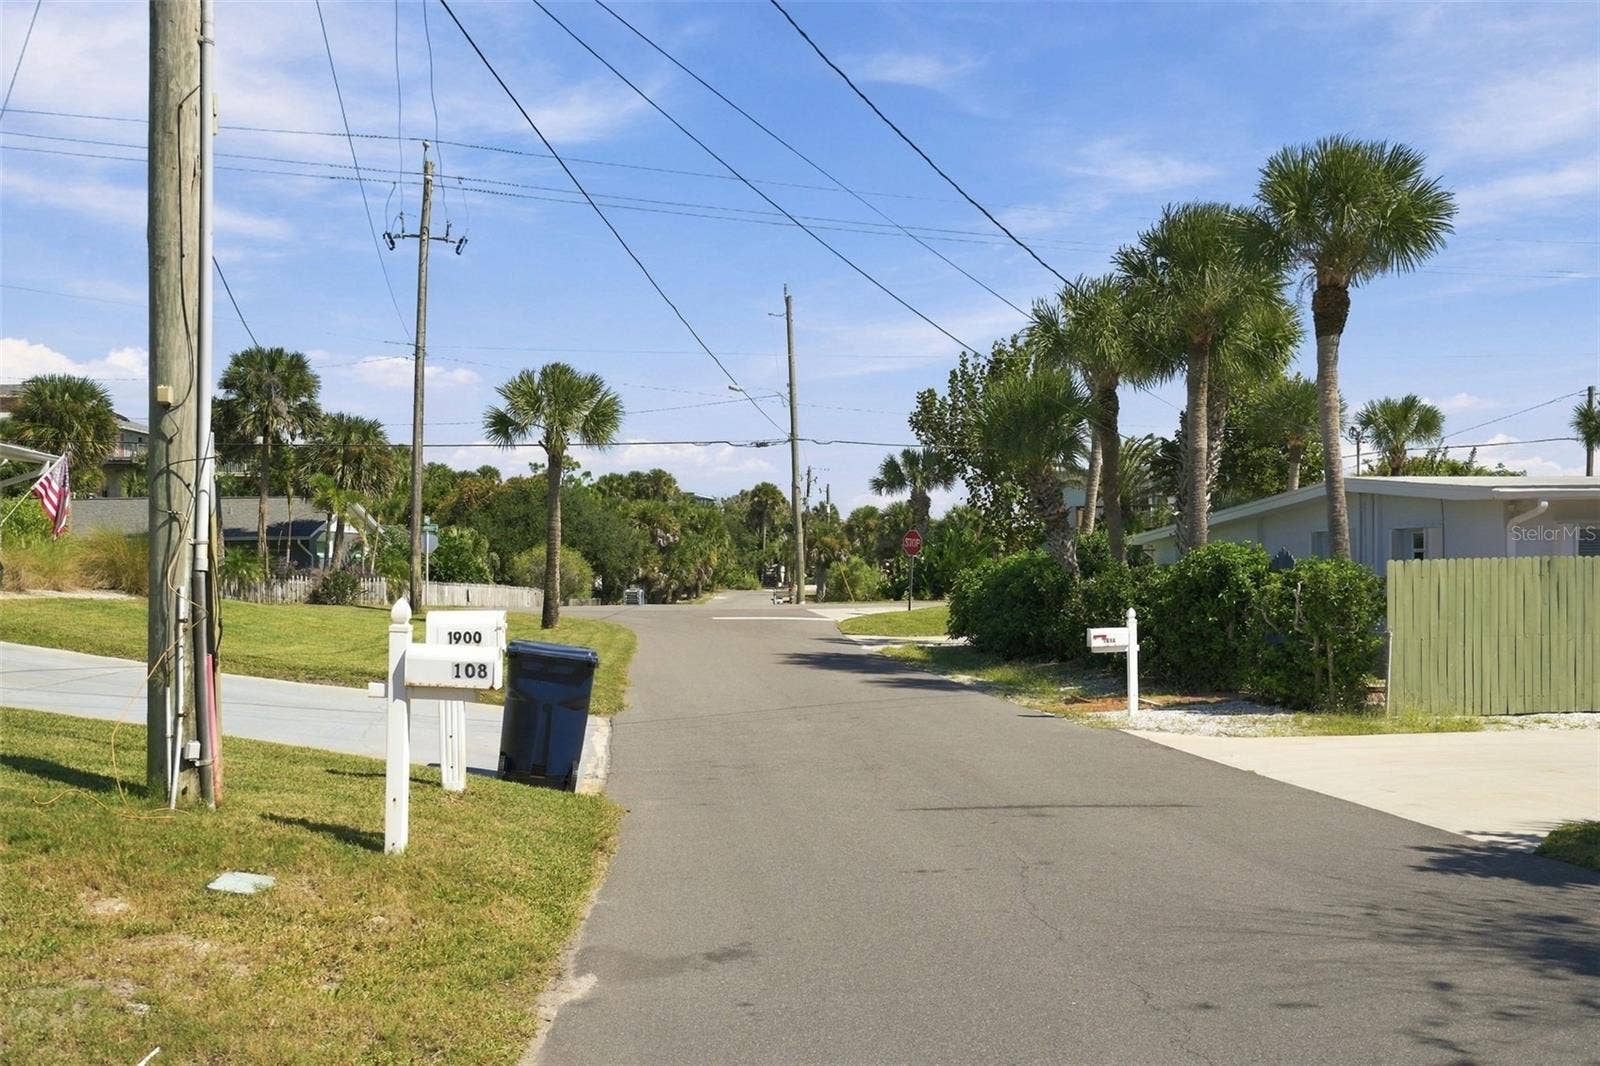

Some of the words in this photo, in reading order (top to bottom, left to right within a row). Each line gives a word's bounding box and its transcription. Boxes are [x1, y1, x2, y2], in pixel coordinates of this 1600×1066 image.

[904, 537, 921, 548] STOP
[447, 631, 482, 645] 1900
[454, 662, 488, 679] 108
